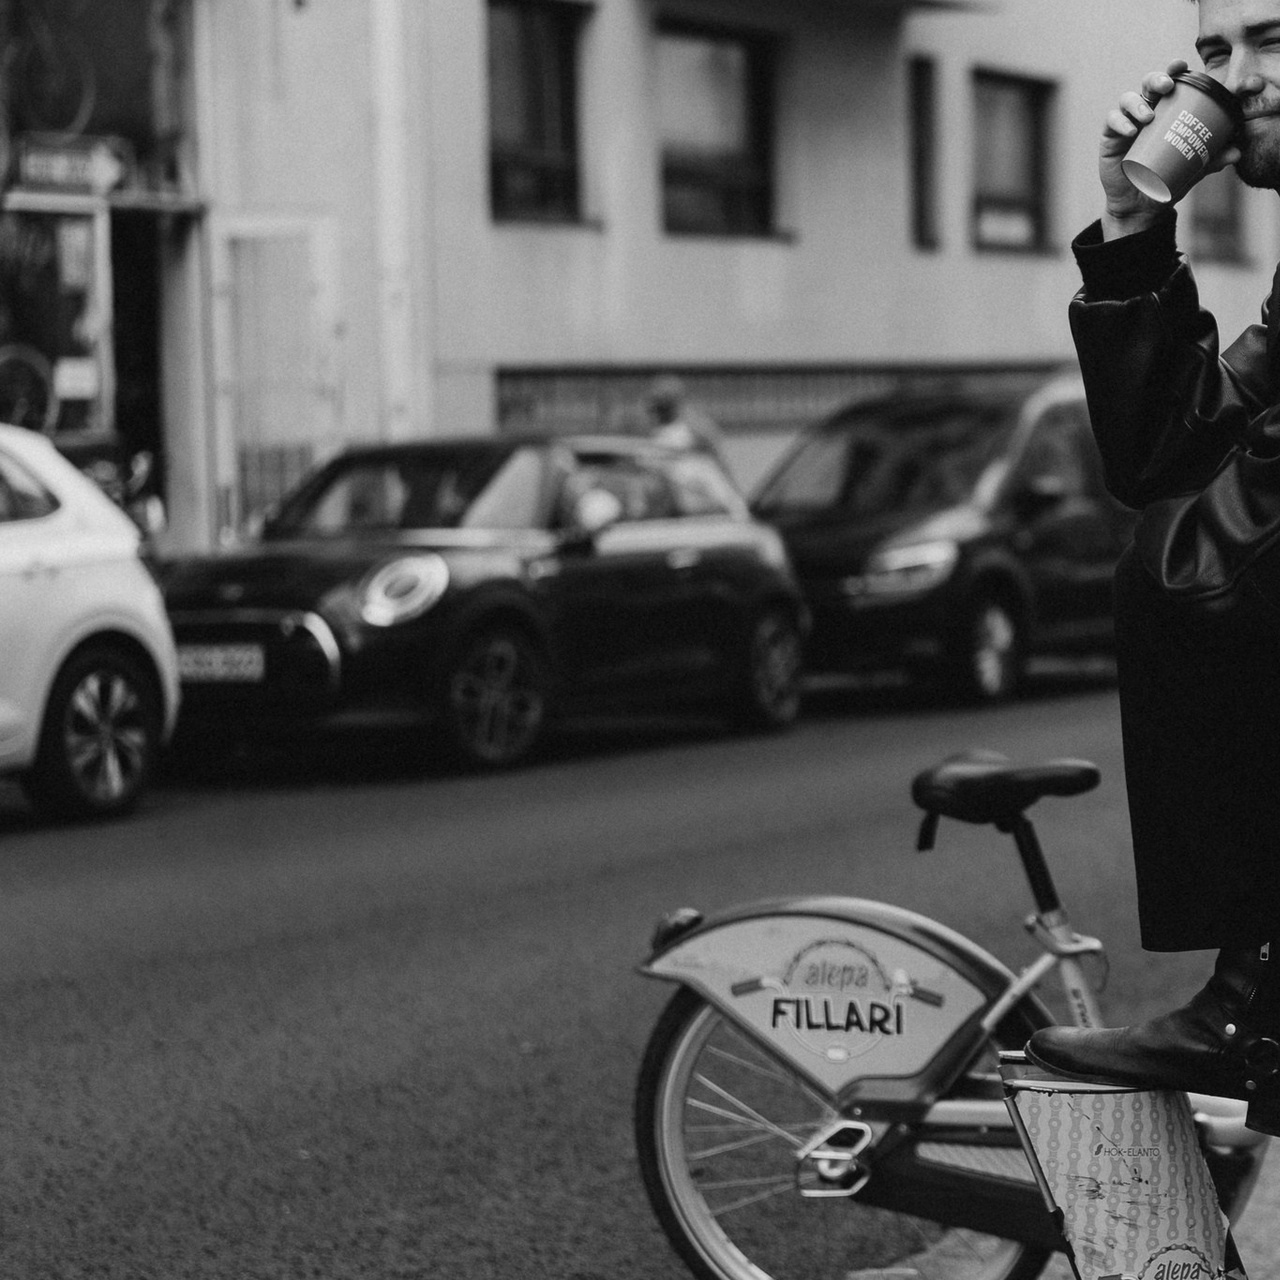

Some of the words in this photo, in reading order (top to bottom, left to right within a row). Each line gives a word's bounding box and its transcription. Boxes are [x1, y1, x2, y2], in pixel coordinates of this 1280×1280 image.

[1178, 110, 1213, 142] COFFEE
[1163, 130, 1196, 161] WOMEN
[804, 961, 869, 991] alepa
[772, 998, 902, 1035] FILLARI
[1103, 1147, 1160, 1157] HOK-ELANTO
